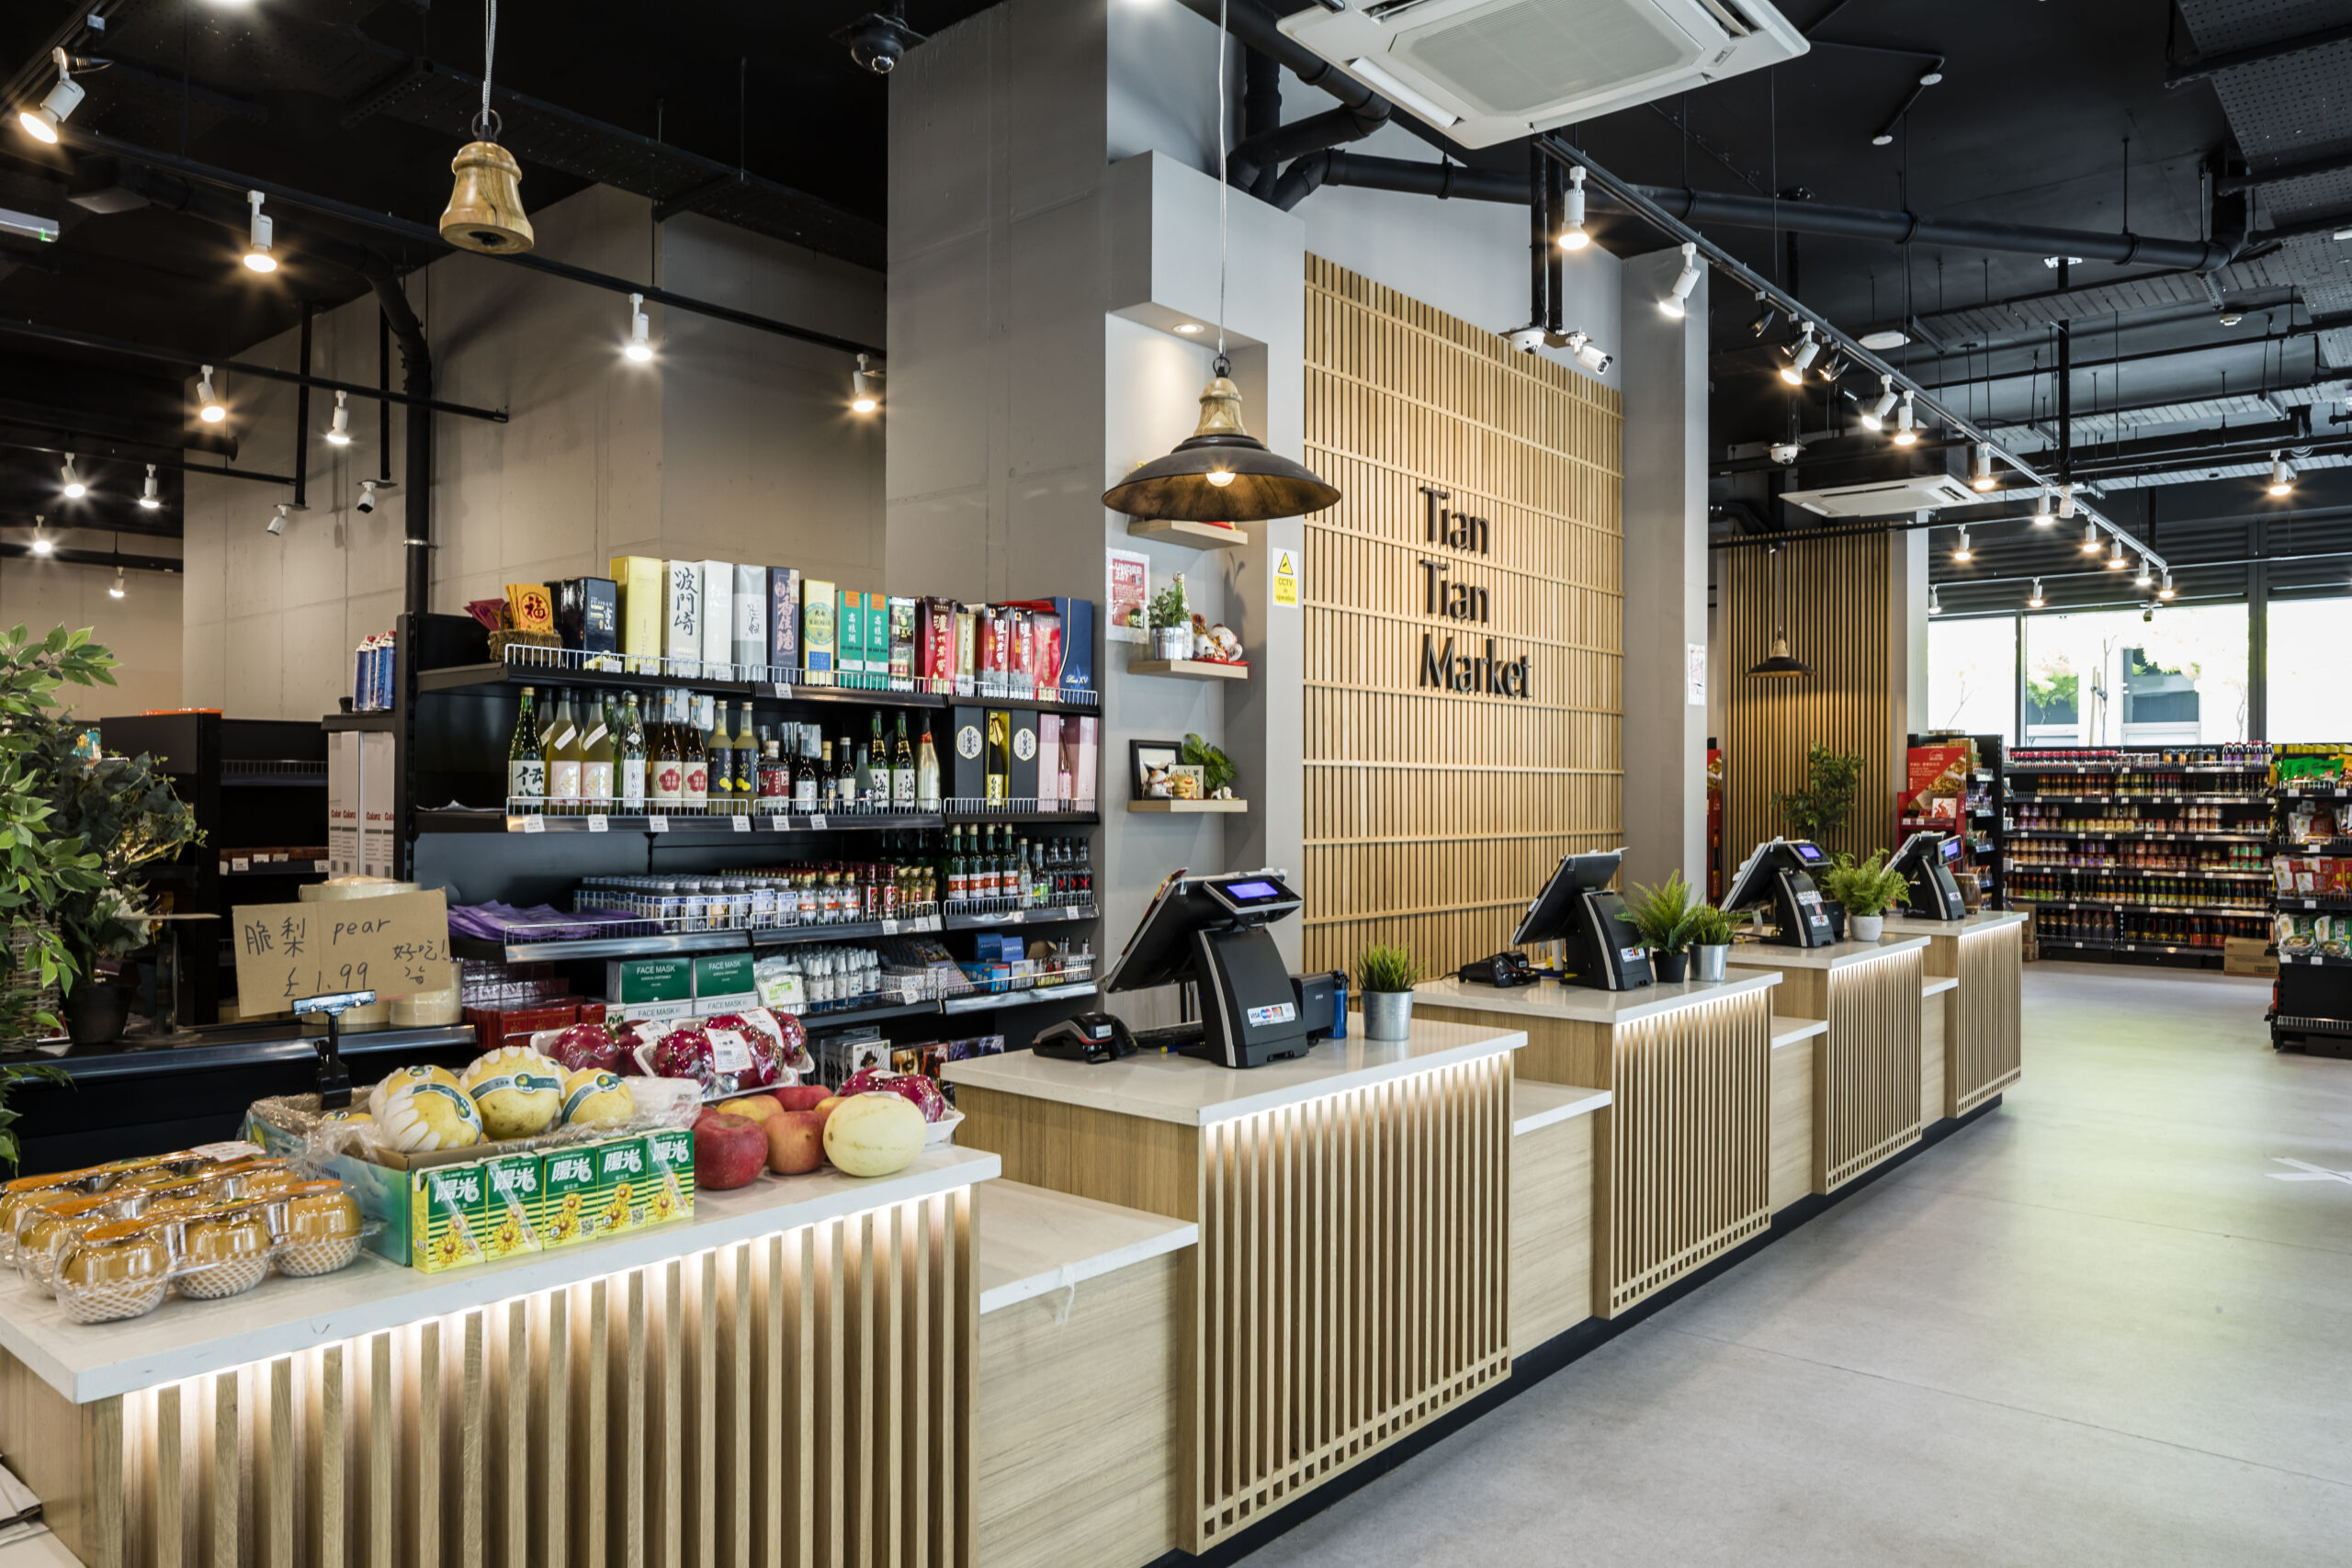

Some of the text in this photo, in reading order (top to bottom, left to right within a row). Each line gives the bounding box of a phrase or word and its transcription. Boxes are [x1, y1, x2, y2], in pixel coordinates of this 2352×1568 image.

[1419, 486, 1490, 554] Tian
[1114, 561, 1143, 574] UNDER
[1278, 578, 1293, 587] CCTV
[1419, 558, 1490, 623] Tian
[524, 594, 547, 619] 福
[673, 566, 698, 636] 波門崎
[1419, 633, 1533, 698] Market
[343, 809, 356, 819] Galanz
[366, 811, 381, 821] Galanz
[333, 919, 391, 946] pear
[637, 964, 675, 975] FACE MASK
[708, 960, 741, 971] FACE MASK
[707, 999, 742, 1010] FACE MASK
[603, 1147, 643, 1174] 陽光
[651, 1138, 690, 1163] 陽光
[492, 1166, 537, 1193] 陽光
[550, 1156, 594, 1183] 陽光
[434, 1176, 481, 1203] 陽光
